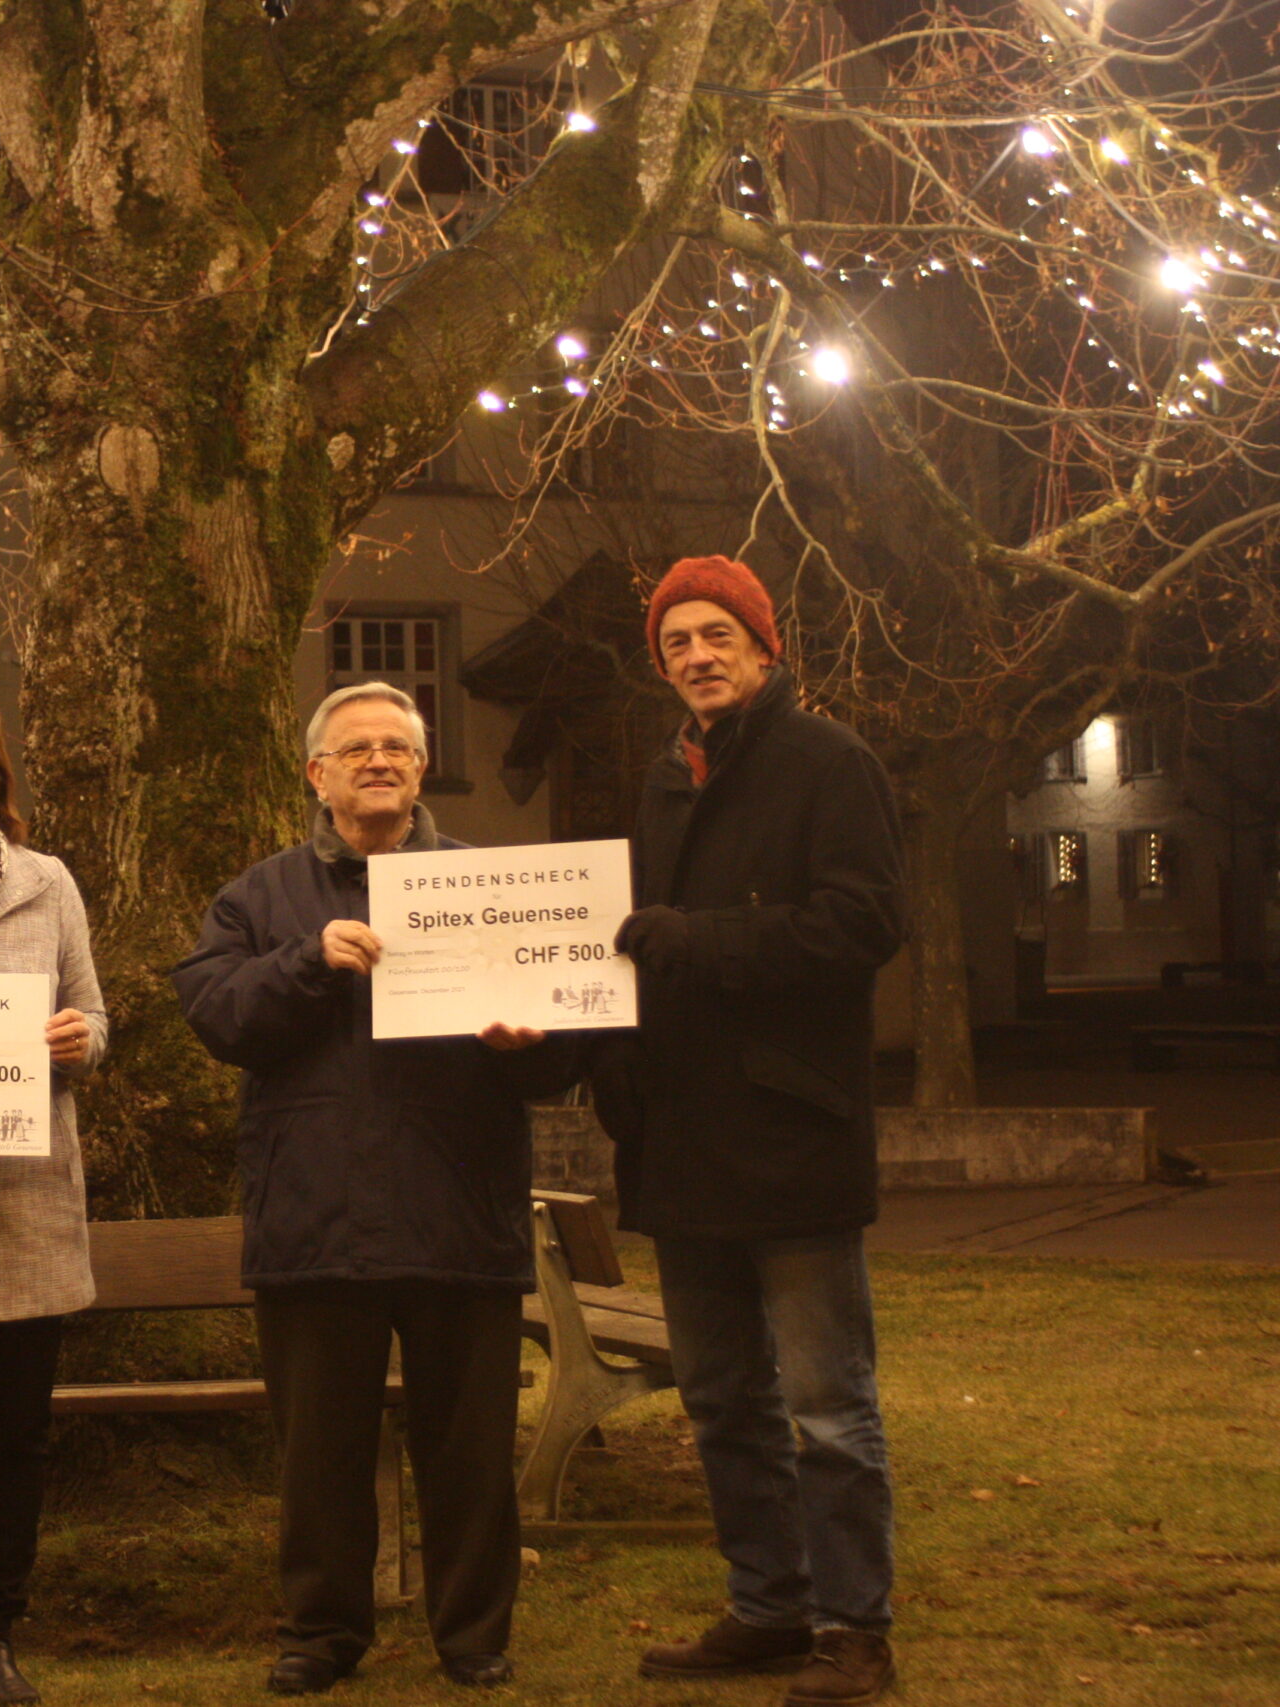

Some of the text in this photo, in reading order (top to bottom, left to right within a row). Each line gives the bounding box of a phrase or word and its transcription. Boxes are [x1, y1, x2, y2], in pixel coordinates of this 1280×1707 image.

[404, 868, 590, 891] SPENDENSCHECK
[408, 905, 589, 932] Spitex Geuensee
[515, 945, 560, 965] CHF
